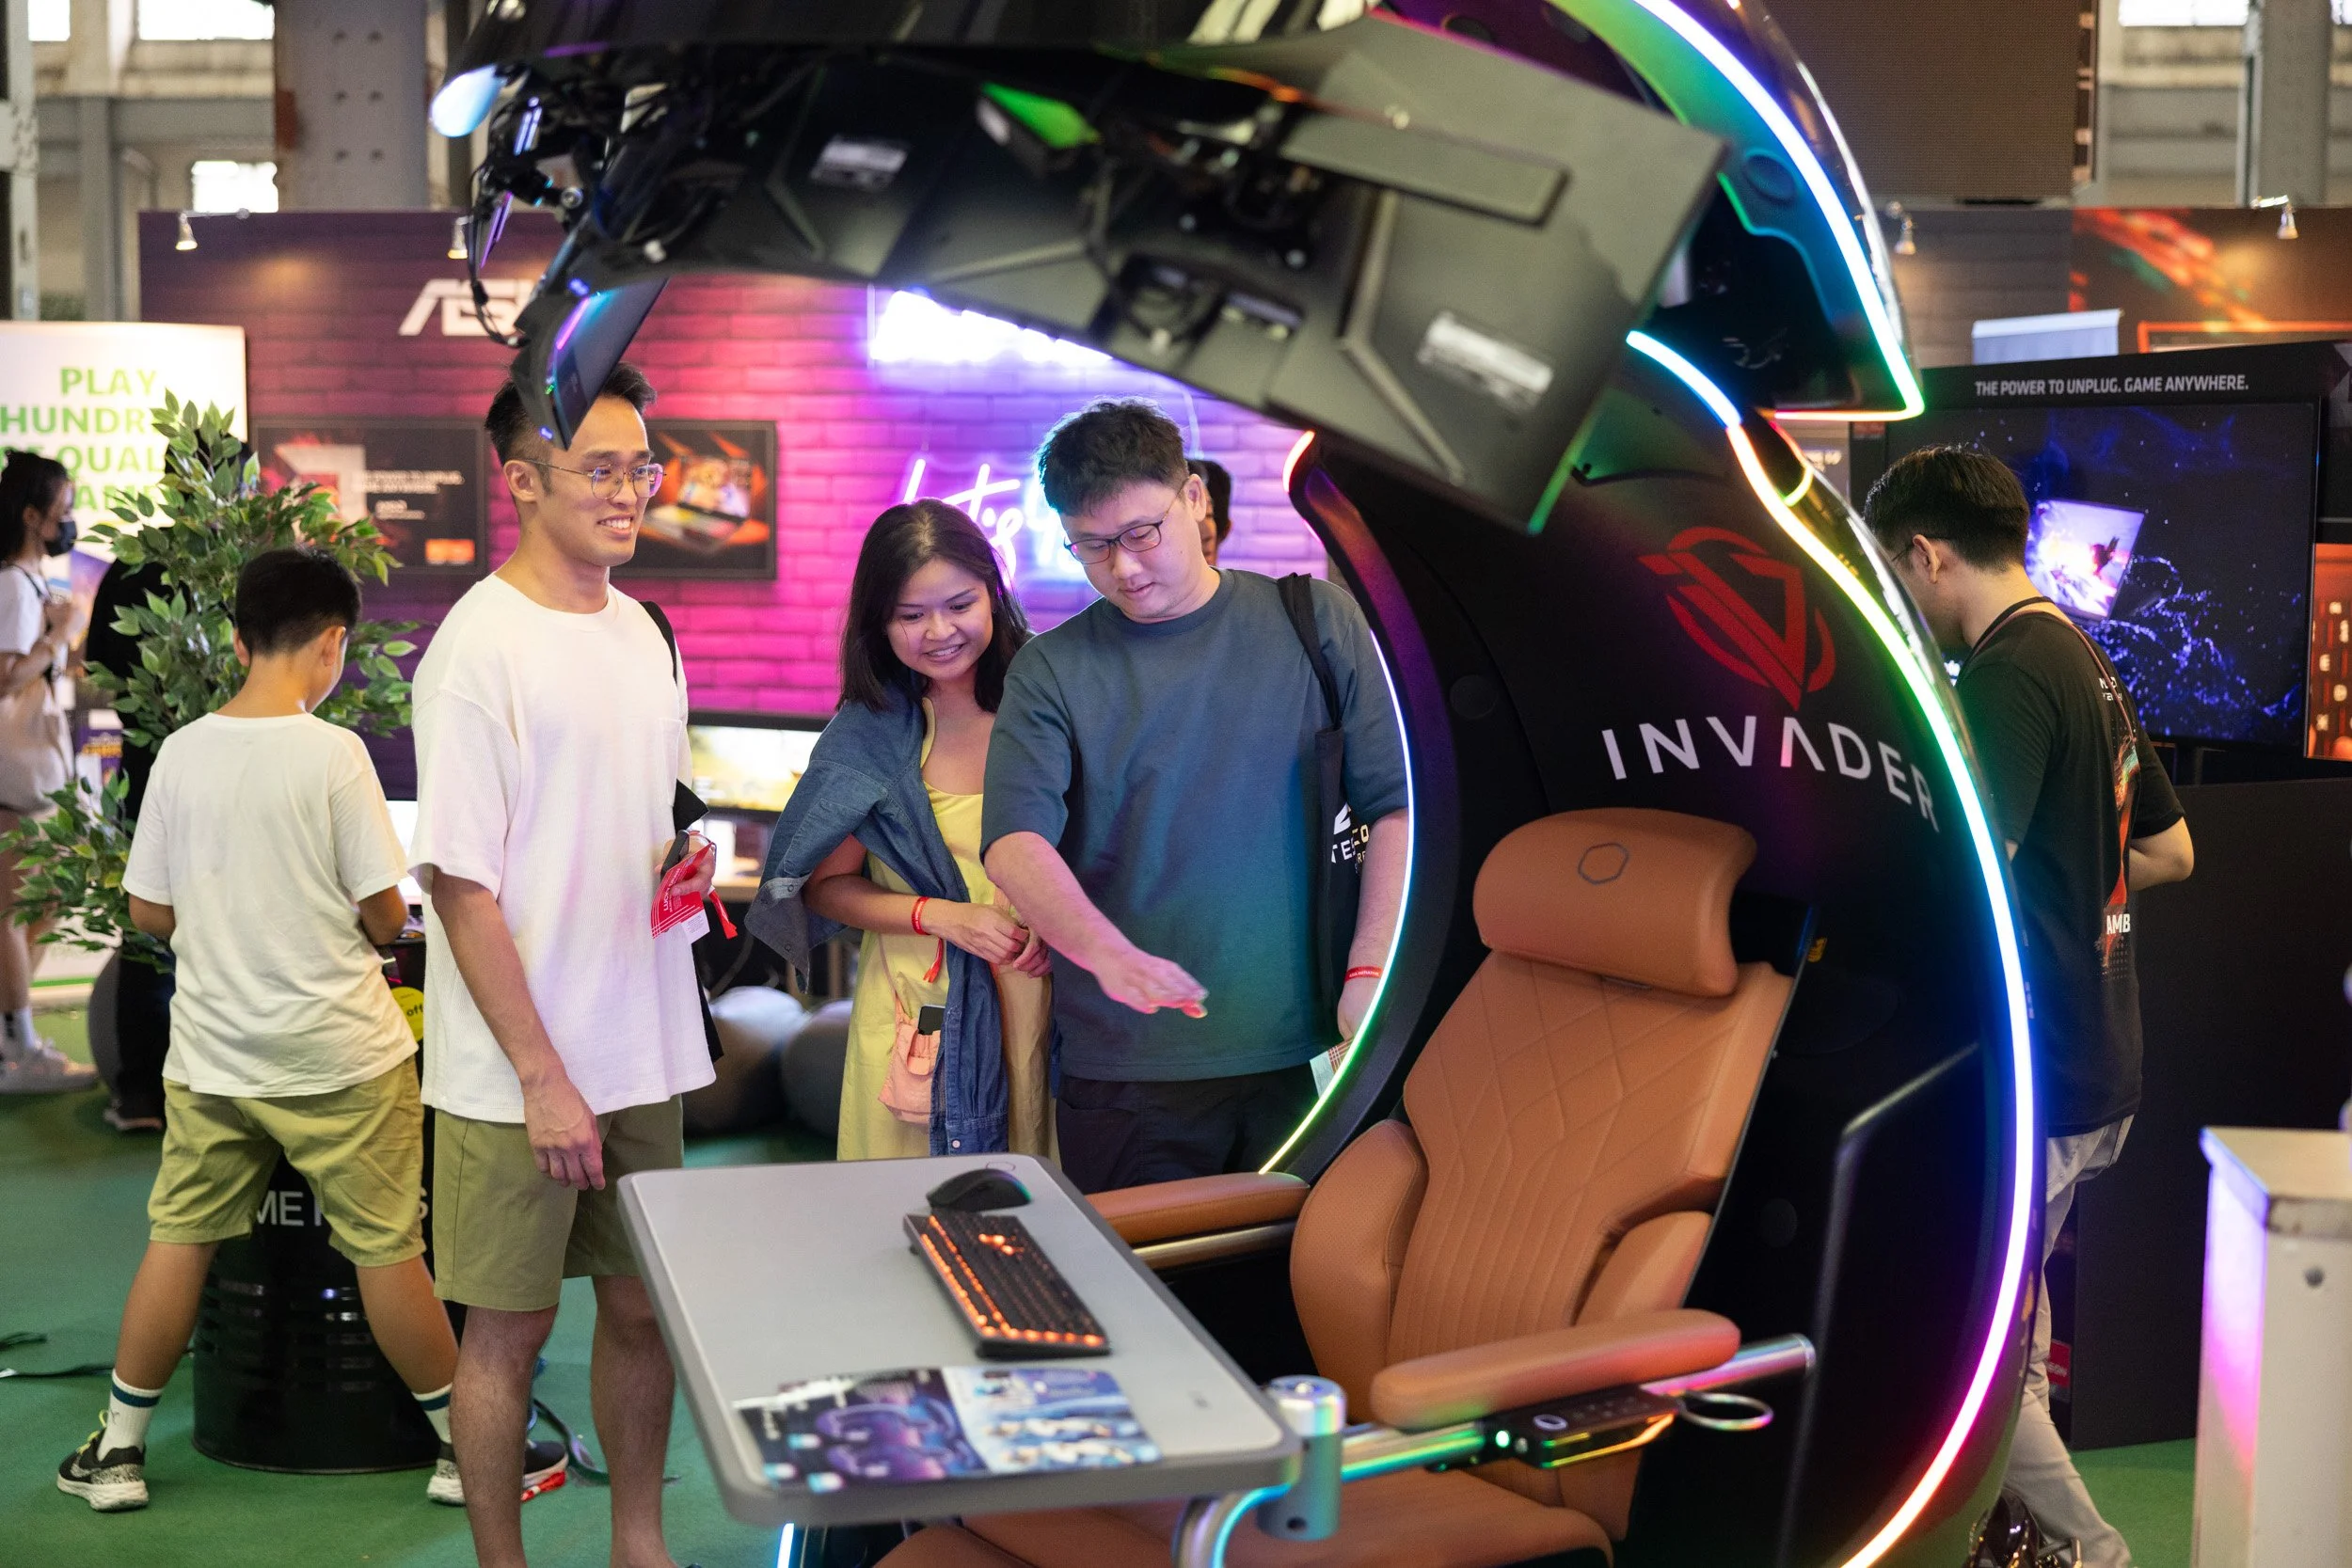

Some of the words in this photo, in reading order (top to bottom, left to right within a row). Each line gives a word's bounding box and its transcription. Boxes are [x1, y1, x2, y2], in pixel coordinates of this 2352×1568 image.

[398, 278, 534, 336] AS
[60, 367, 157, 396] PLAY
[1975, 381, 1998, 396] THE
[2000, 380, 2045, 396] POWER
[2048, 378, 2065, 394] TO
[2067, 377, 2122, 394] UNPLUG.
[2124, 376, 2163, 393] GAME
[2165, 374, 2249, 391] ANYWHERE.
[0, 405, 158, 435] HUNDR
[56, 446, 164, 480] QUAL
[1601, 715, 1940, 832] INVADER
